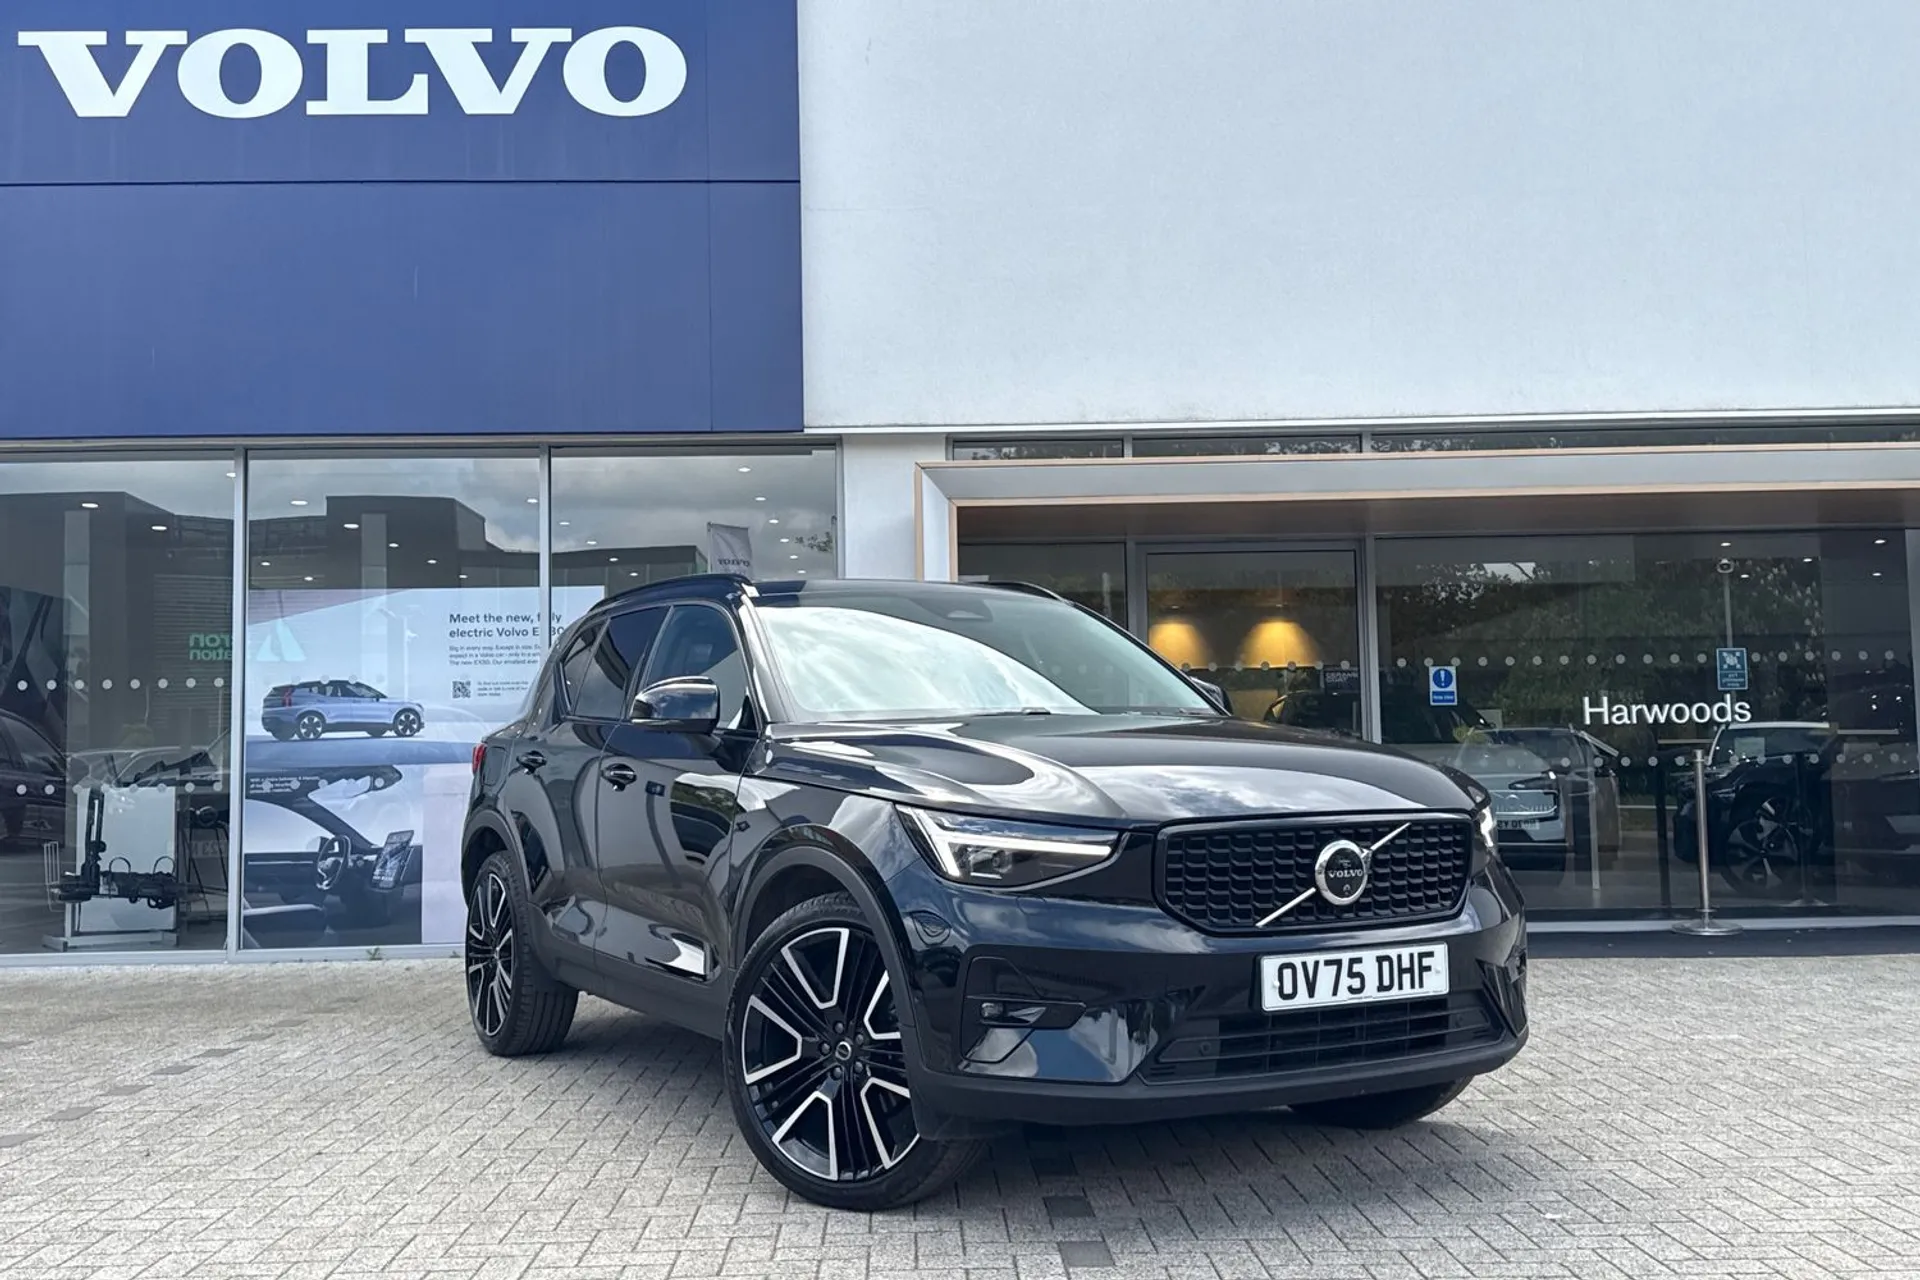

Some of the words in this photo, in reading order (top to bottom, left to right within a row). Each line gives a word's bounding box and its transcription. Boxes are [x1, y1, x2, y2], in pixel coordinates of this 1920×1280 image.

[18, 26, 687, 118] VOLVO
[449, 613, 480, 624] Meet
[483, 613, 504, 623] the
[505, 614, 534, 624] new,
[537, 612, 562, 623] fly
[449, 628, 494, 638] electric
[496, 627, 529, 637] Volvo
[532, 627, 565, 637] E30
[1582, 693, 1752, 725] Harwoods
[1328, 869, 1363, 878] VOLVO
[1278, 957, 1366, 1001] OV75
[1376, 951, 1434, 993] DHF
